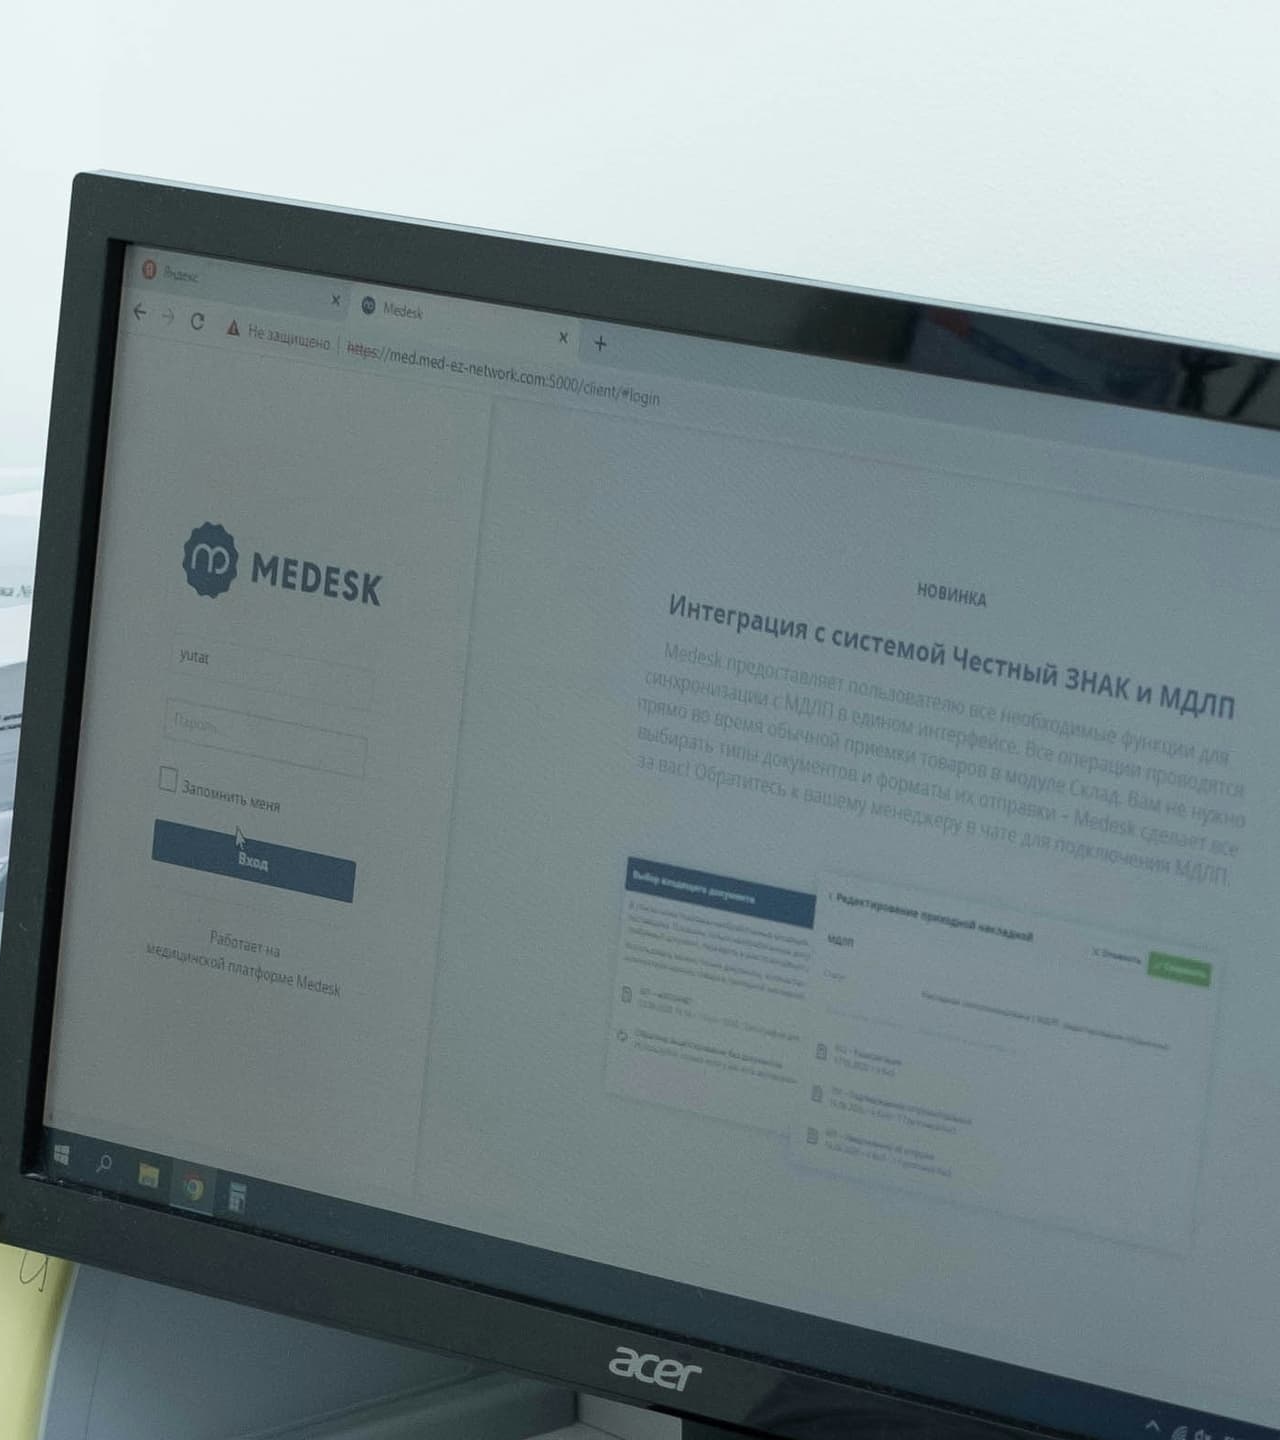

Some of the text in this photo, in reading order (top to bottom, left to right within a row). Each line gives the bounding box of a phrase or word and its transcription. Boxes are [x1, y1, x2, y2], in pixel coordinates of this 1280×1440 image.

[248, 323, 331, 351] Не защищено
[384, 301, 423, 320] Medesk
[251, 551, 383, 607] MEDESK
[916, 581, 987, 608] НОВИНКА
[669, 592, 1236, 720] Интеграция с системой Честный ЗНАК и МДЛП
[664, 642, 1230, 767] Medesk предоставляет пользователю все необходимые функции для
[637, 696, 688, 720] прямо
[691, 707, 711, 724] во
[714, 711, 764, 735] время
[767, 720, 840, 750] обычной
[844, 736, 917, 762] приемки
[920, 752, 987, 779] товаров
[990, 766, 1001, 781] в
[1006, 770, 1066, 794] модуле
[1127, 790, 1162, 812] Вам
[1165, 801, 1186, 818] не
[1191, 806, 1247, 829] нужно
[644, 671, 769, 707] синхронизации
[785, 692, 834, 720] МДЛП
[837, 707, 848, 722] в
[852, 710, 914, 734] едином
[1026, 740, 1054, 762] Все
[1057, 750, 1142, 778] операции
[1145, 766, 1246, 799] проводятся
[182, 779, 281, 813] Запомнить меня
[636, 755, 655, 770] за
[694, 763, 788, 799] Обратитесь
[803, 789, 867, 818] вашему
[870, 800, 963, 837] менеджеру
[966, 820, 977, 836] в
[980, 823, 1018, 844] чате
[1020, 833, 1051, 850] для
[1054, 838, 1172, 874] подключения
[637, 725, 715, 754] выбирать
[720, 741, 759, 762] типы
[762, 751, 858, 782] документов
[862, 770, 872, 784] и
[876, 772, 951, 802] форматы
[955, 787, 974, 806] их
[979, 793, 1057, 819] отправки
[1074, 808, 1135, 837] Medesk
[1139, 826, 1208, 851] сделает
[1209, 839, 1240, 858] все
[238, 851, 269, 872] Вход
[146, 942, 342, 998] медицинской платформе Medesk
[209, 929, 281, 959] Работает на
[608, 1345, 703, 1393] acer
